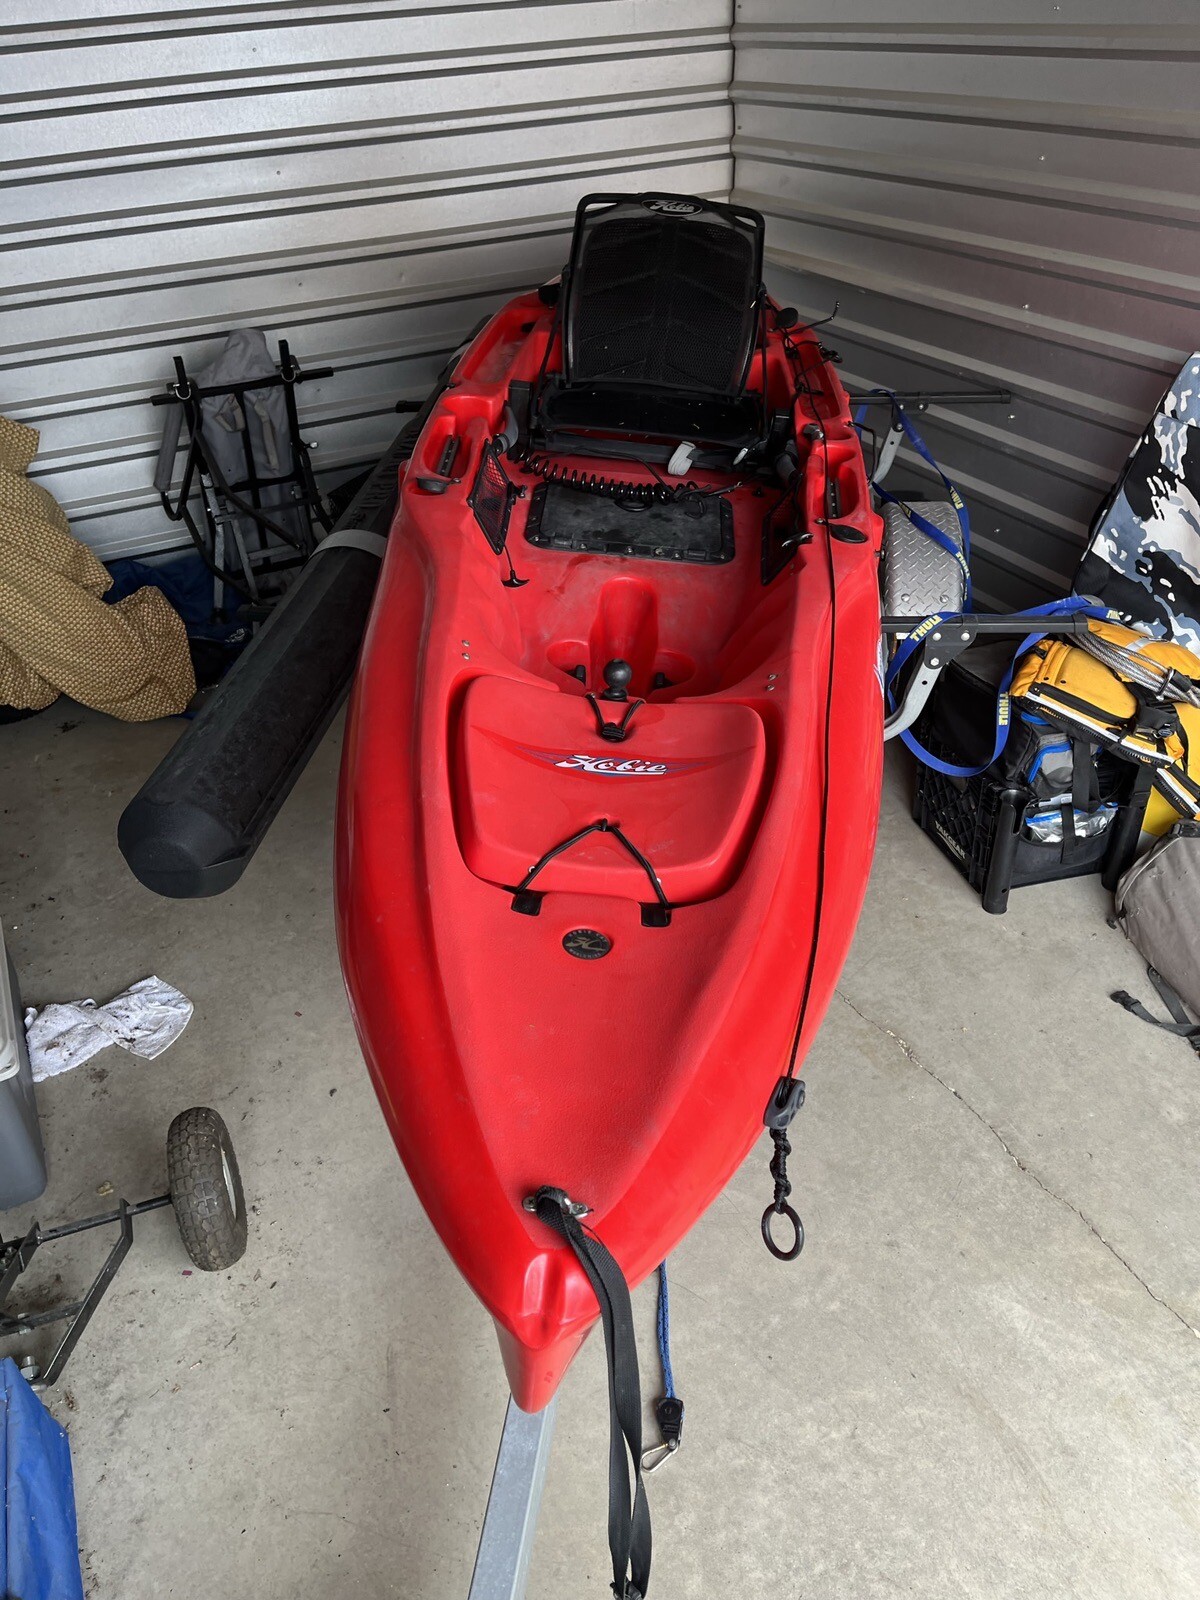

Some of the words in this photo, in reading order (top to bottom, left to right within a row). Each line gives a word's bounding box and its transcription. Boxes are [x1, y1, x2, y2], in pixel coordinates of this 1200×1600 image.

[650, 201, 695, 213] Hobie
[909, 614, 943, 642] THULE
[998, 691, 1009, 726] THULE
[554, 754, 668, 776] Hobie
